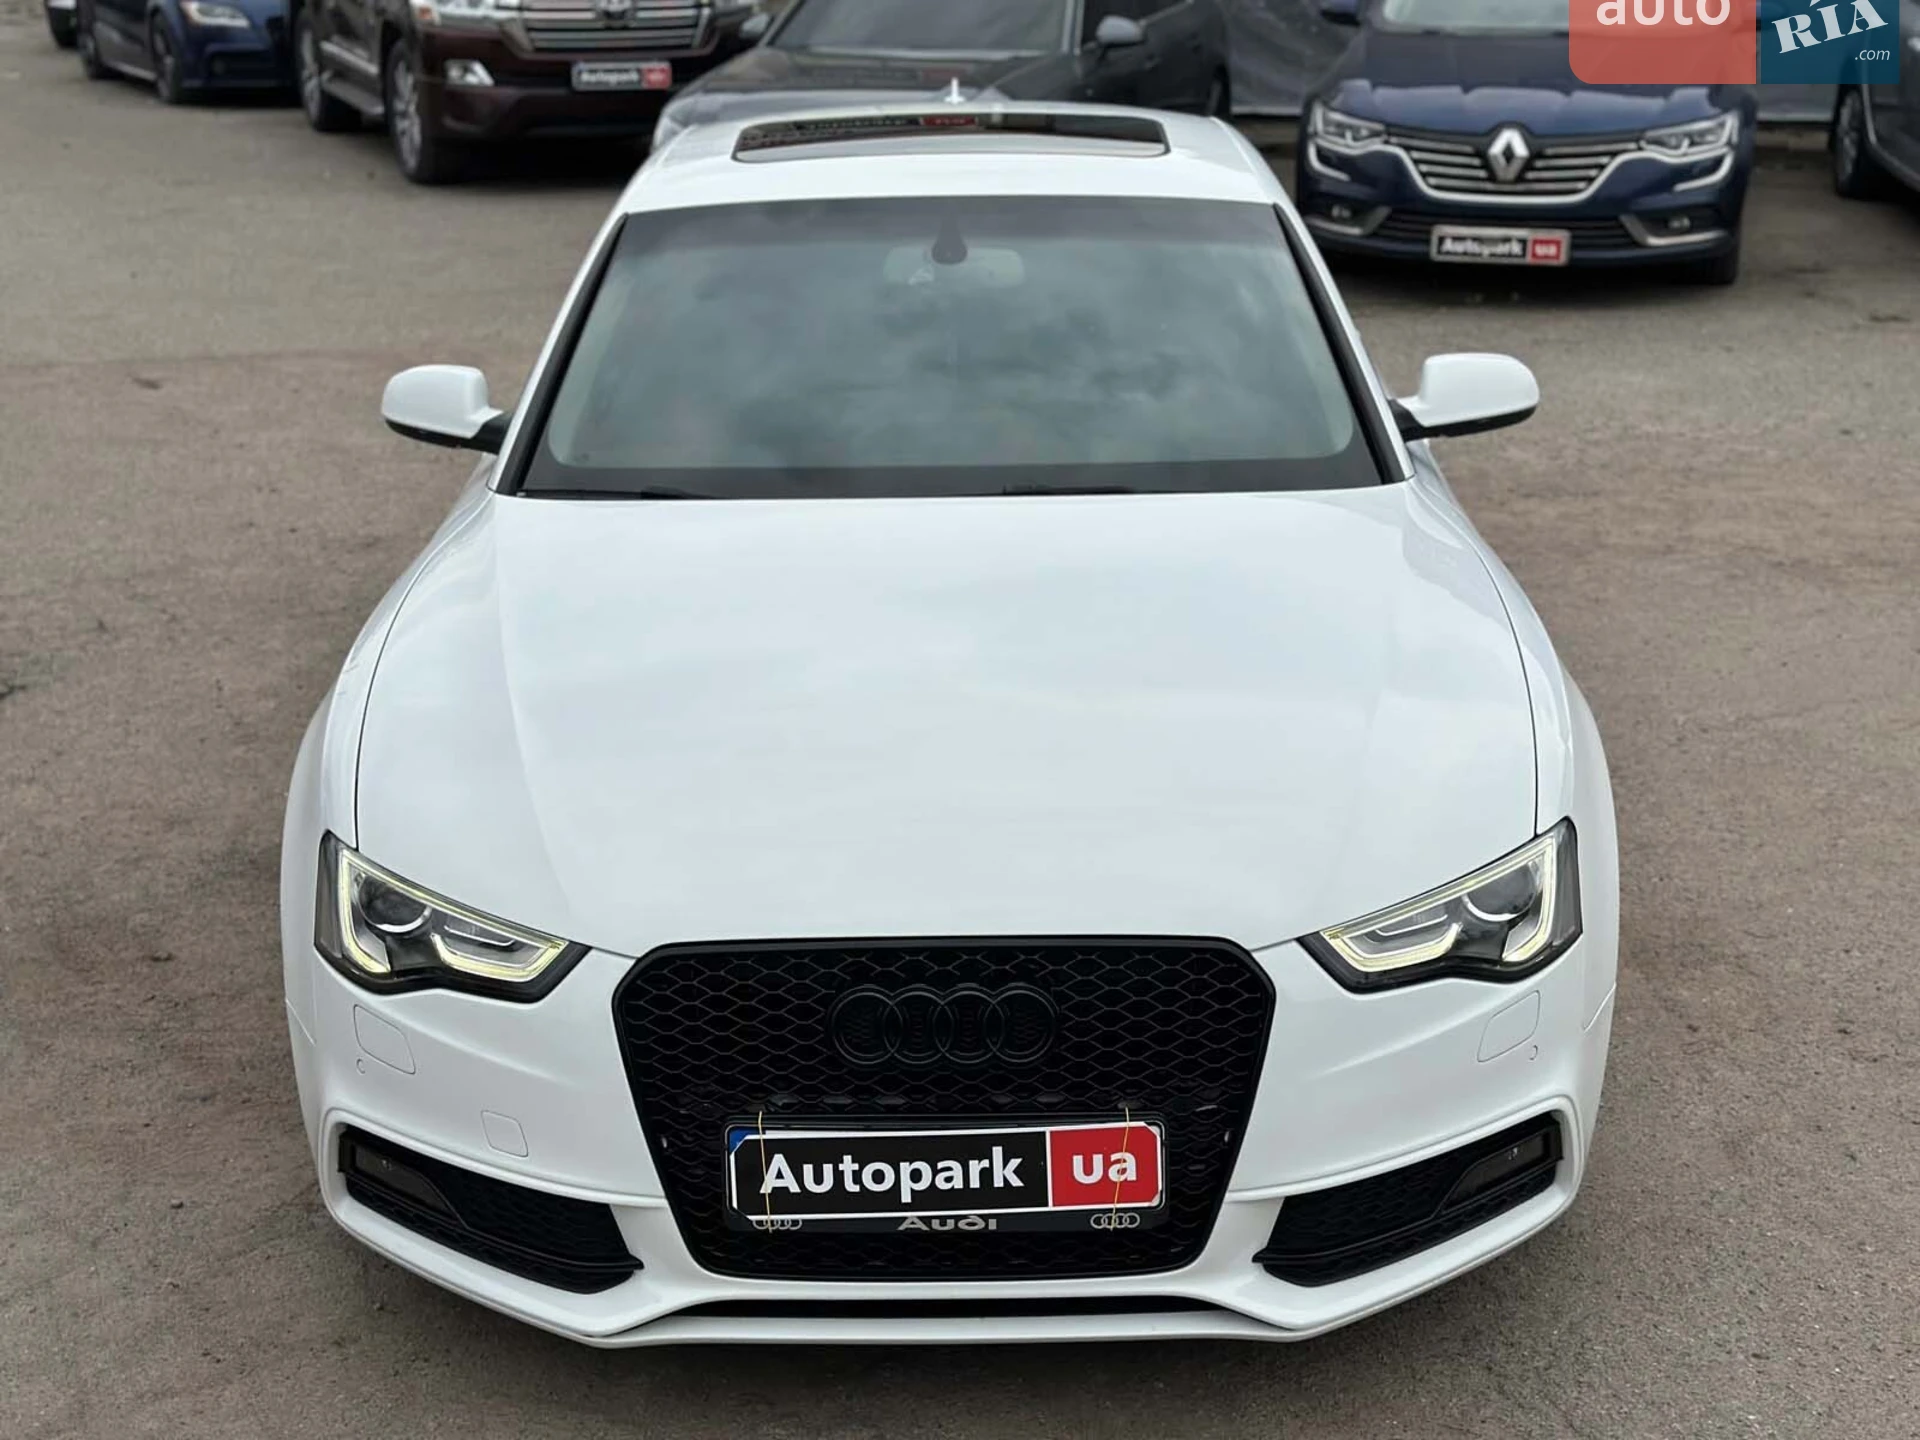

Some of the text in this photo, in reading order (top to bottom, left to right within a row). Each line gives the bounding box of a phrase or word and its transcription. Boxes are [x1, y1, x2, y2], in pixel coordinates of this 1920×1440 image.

[759, 1146, 1138, 1203] Autopark ua
[897, 1215, 998, 1231] Audi
